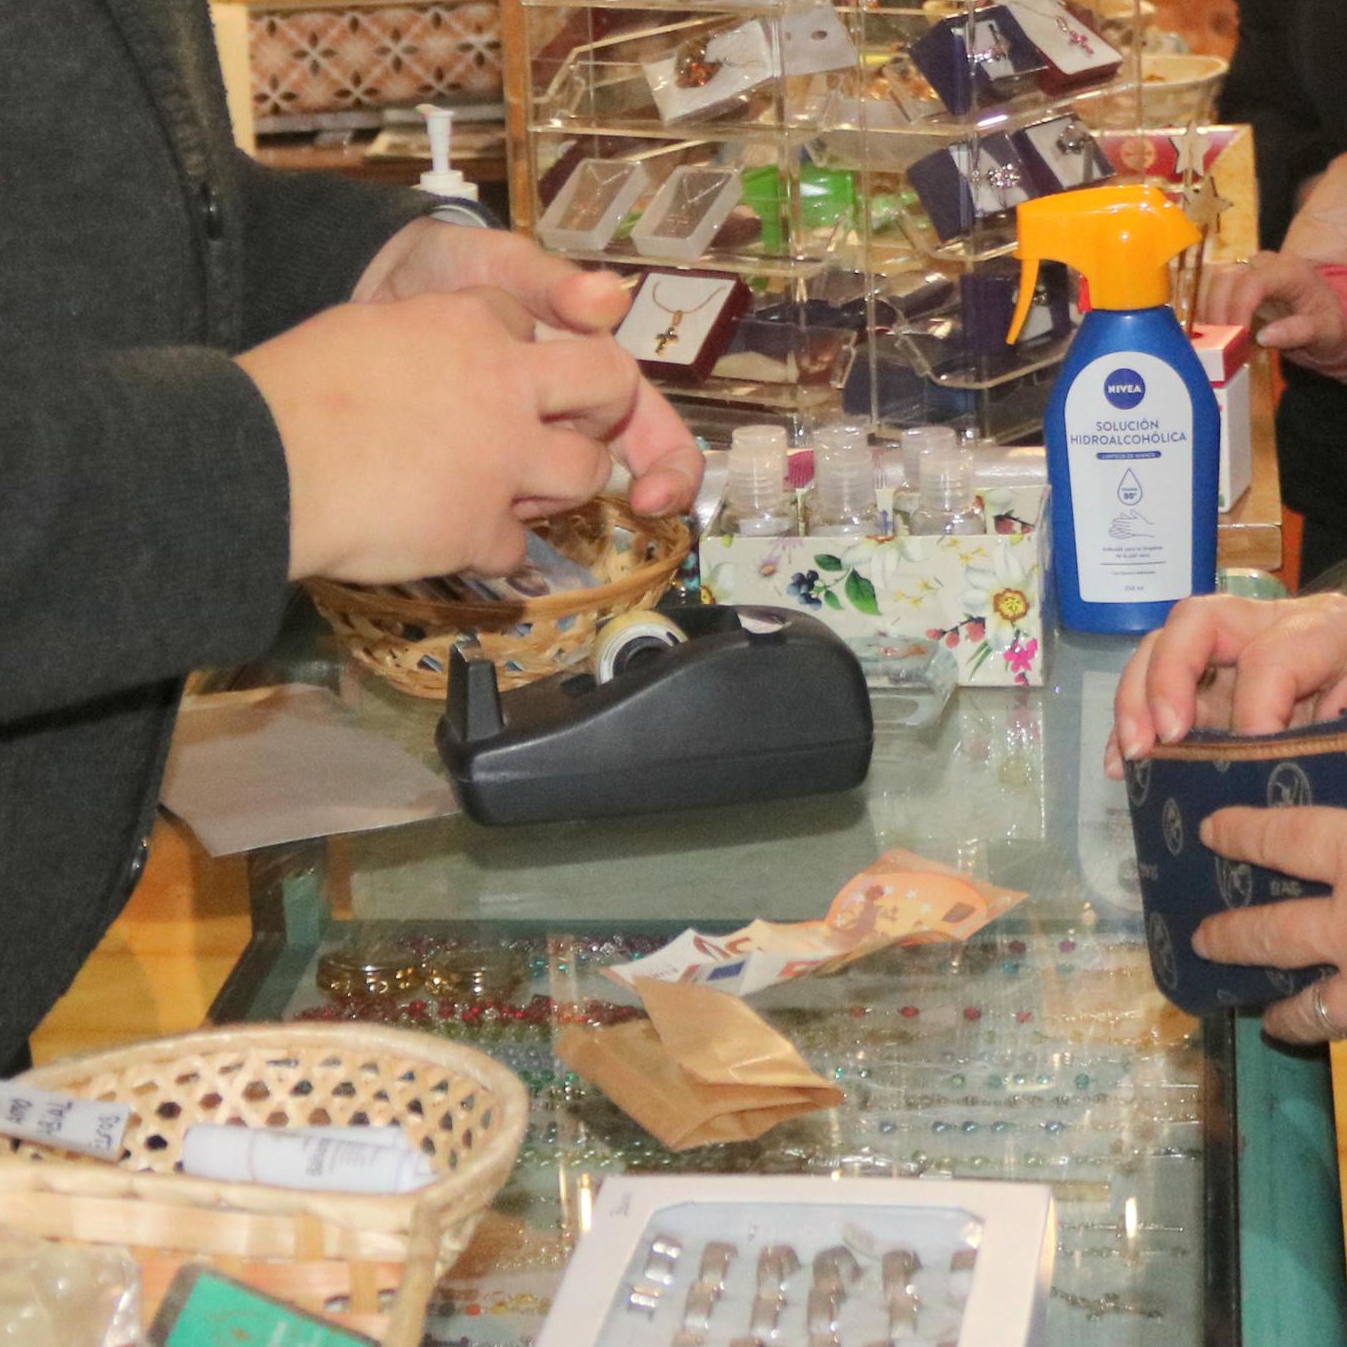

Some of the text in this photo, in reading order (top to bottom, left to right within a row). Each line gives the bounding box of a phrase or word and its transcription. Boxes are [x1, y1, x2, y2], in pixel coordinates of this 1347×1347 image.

[1107, 384, 1142, 394] NIVEA
[1095, 418, 1159, 432] SOLUCIÓN
[1070, 431, 1187, 446] HIDROALCOHÓLICA
